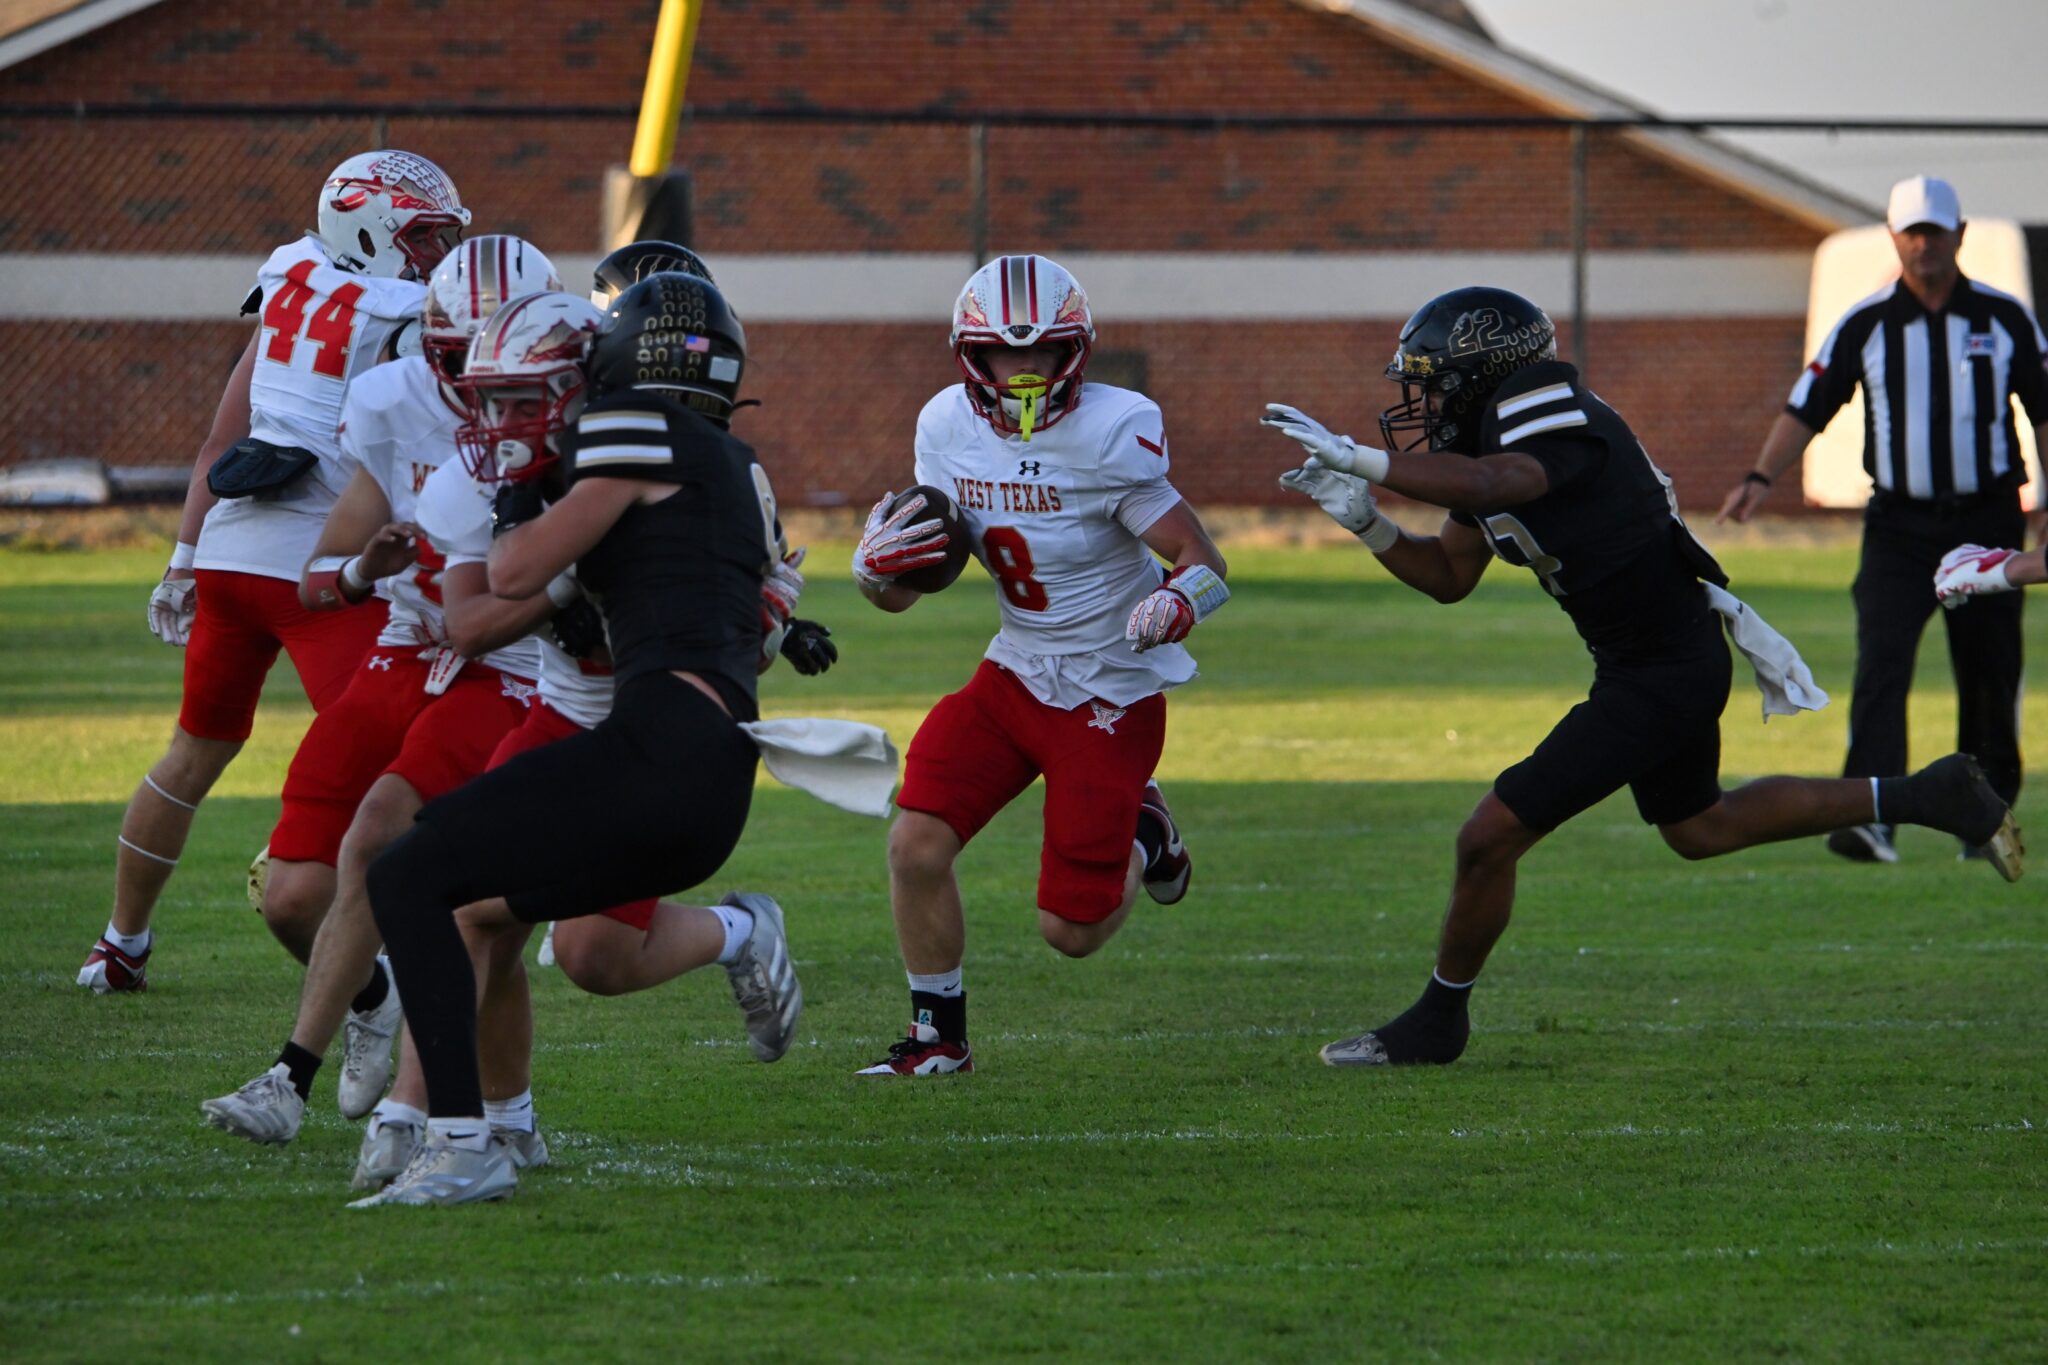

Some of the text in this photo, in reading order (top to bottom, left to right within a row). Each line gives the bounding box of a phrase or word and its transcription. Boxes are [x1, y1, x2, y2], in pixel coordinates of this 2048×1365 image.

[263, 258, 367, 380] 44
[1448, 307, 1508, 358] 22
[953, 477, 1062, 513] WEST TEXAS
[982, 525, 1050, 613] 8
